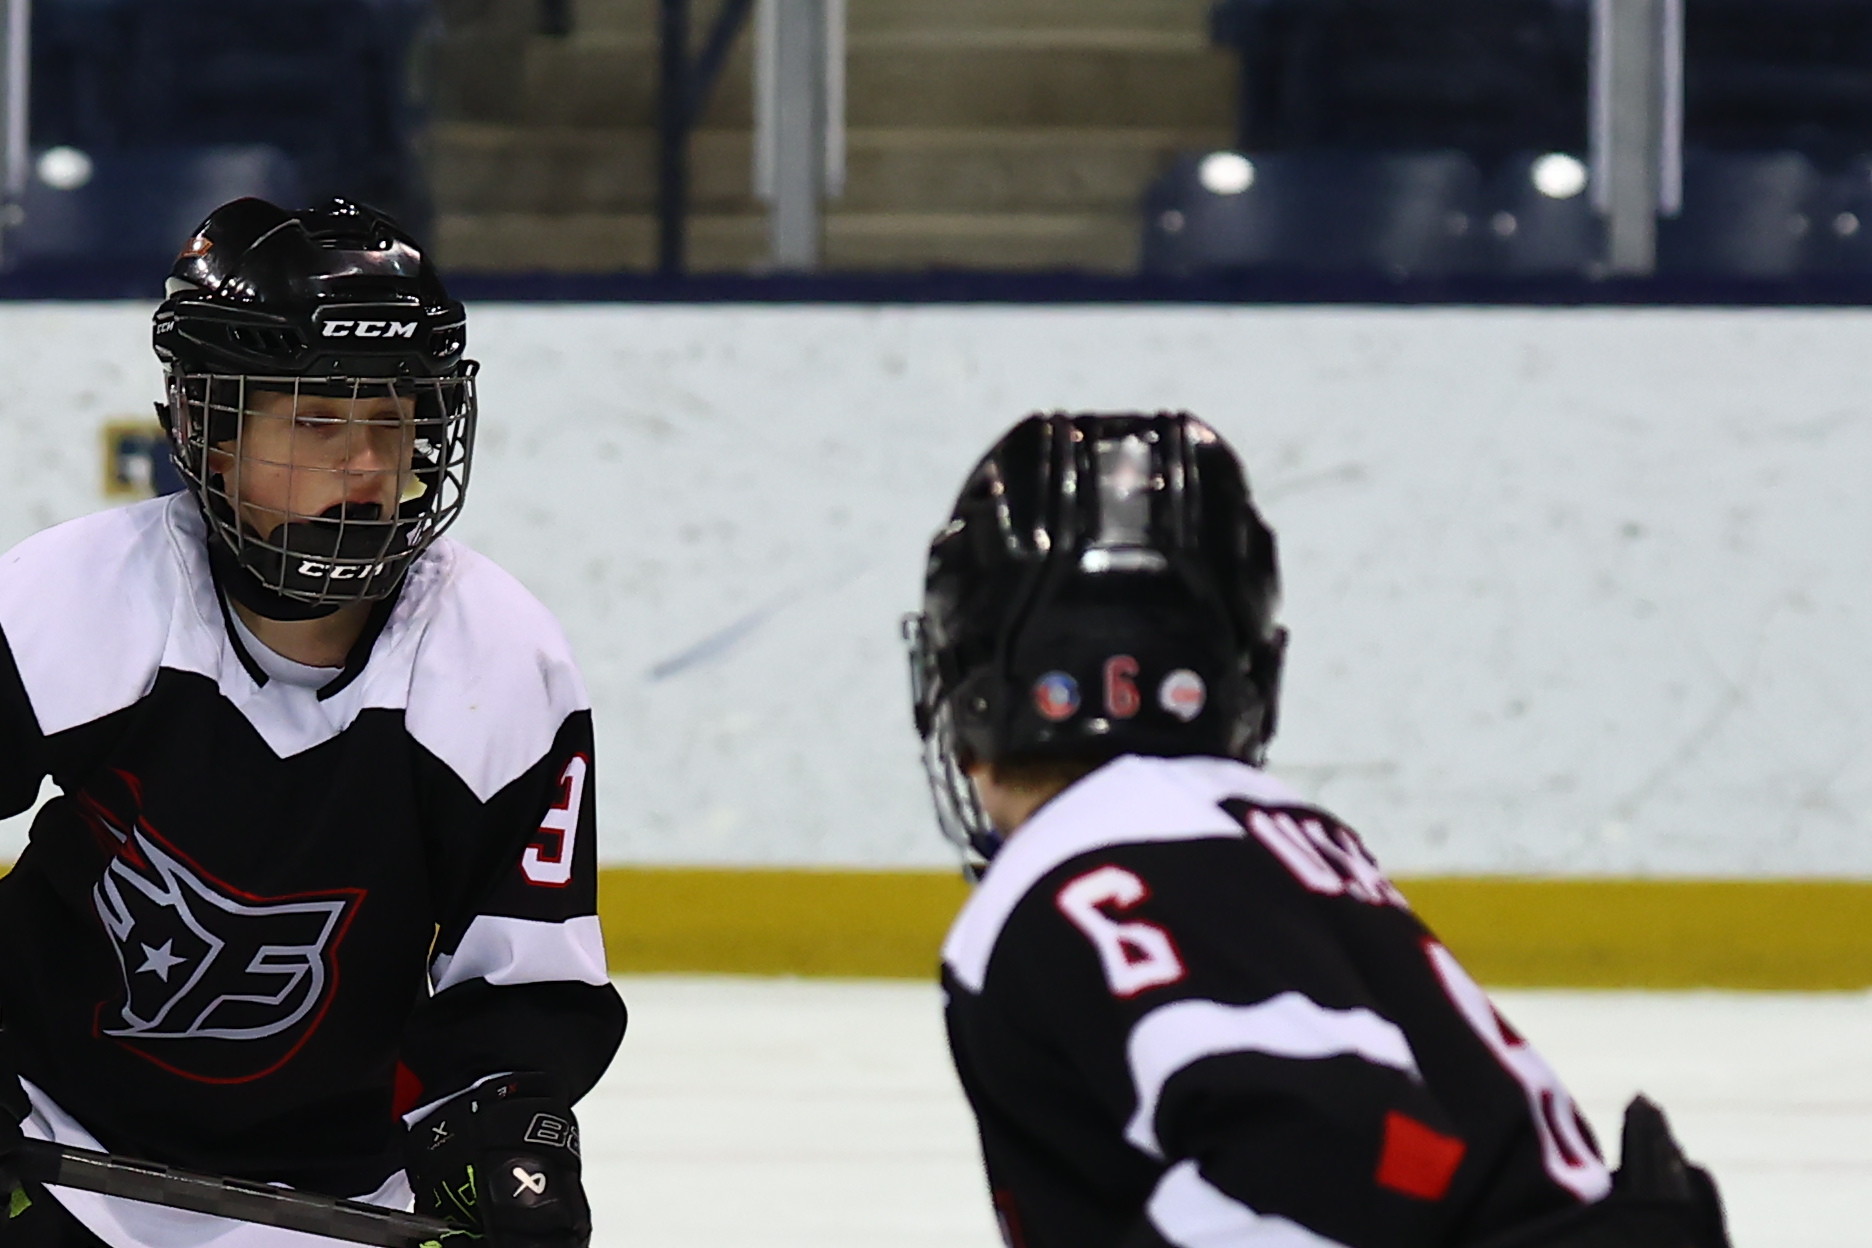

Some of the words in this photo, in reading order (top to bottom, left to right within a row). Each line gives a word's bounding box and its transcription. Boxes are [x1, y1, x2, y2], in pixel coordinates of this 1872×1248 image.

[322, 320, 418, 338] CCM
[1103, 654, 1141, 719] 6
[1054, 864, 1188, 1000] 6
